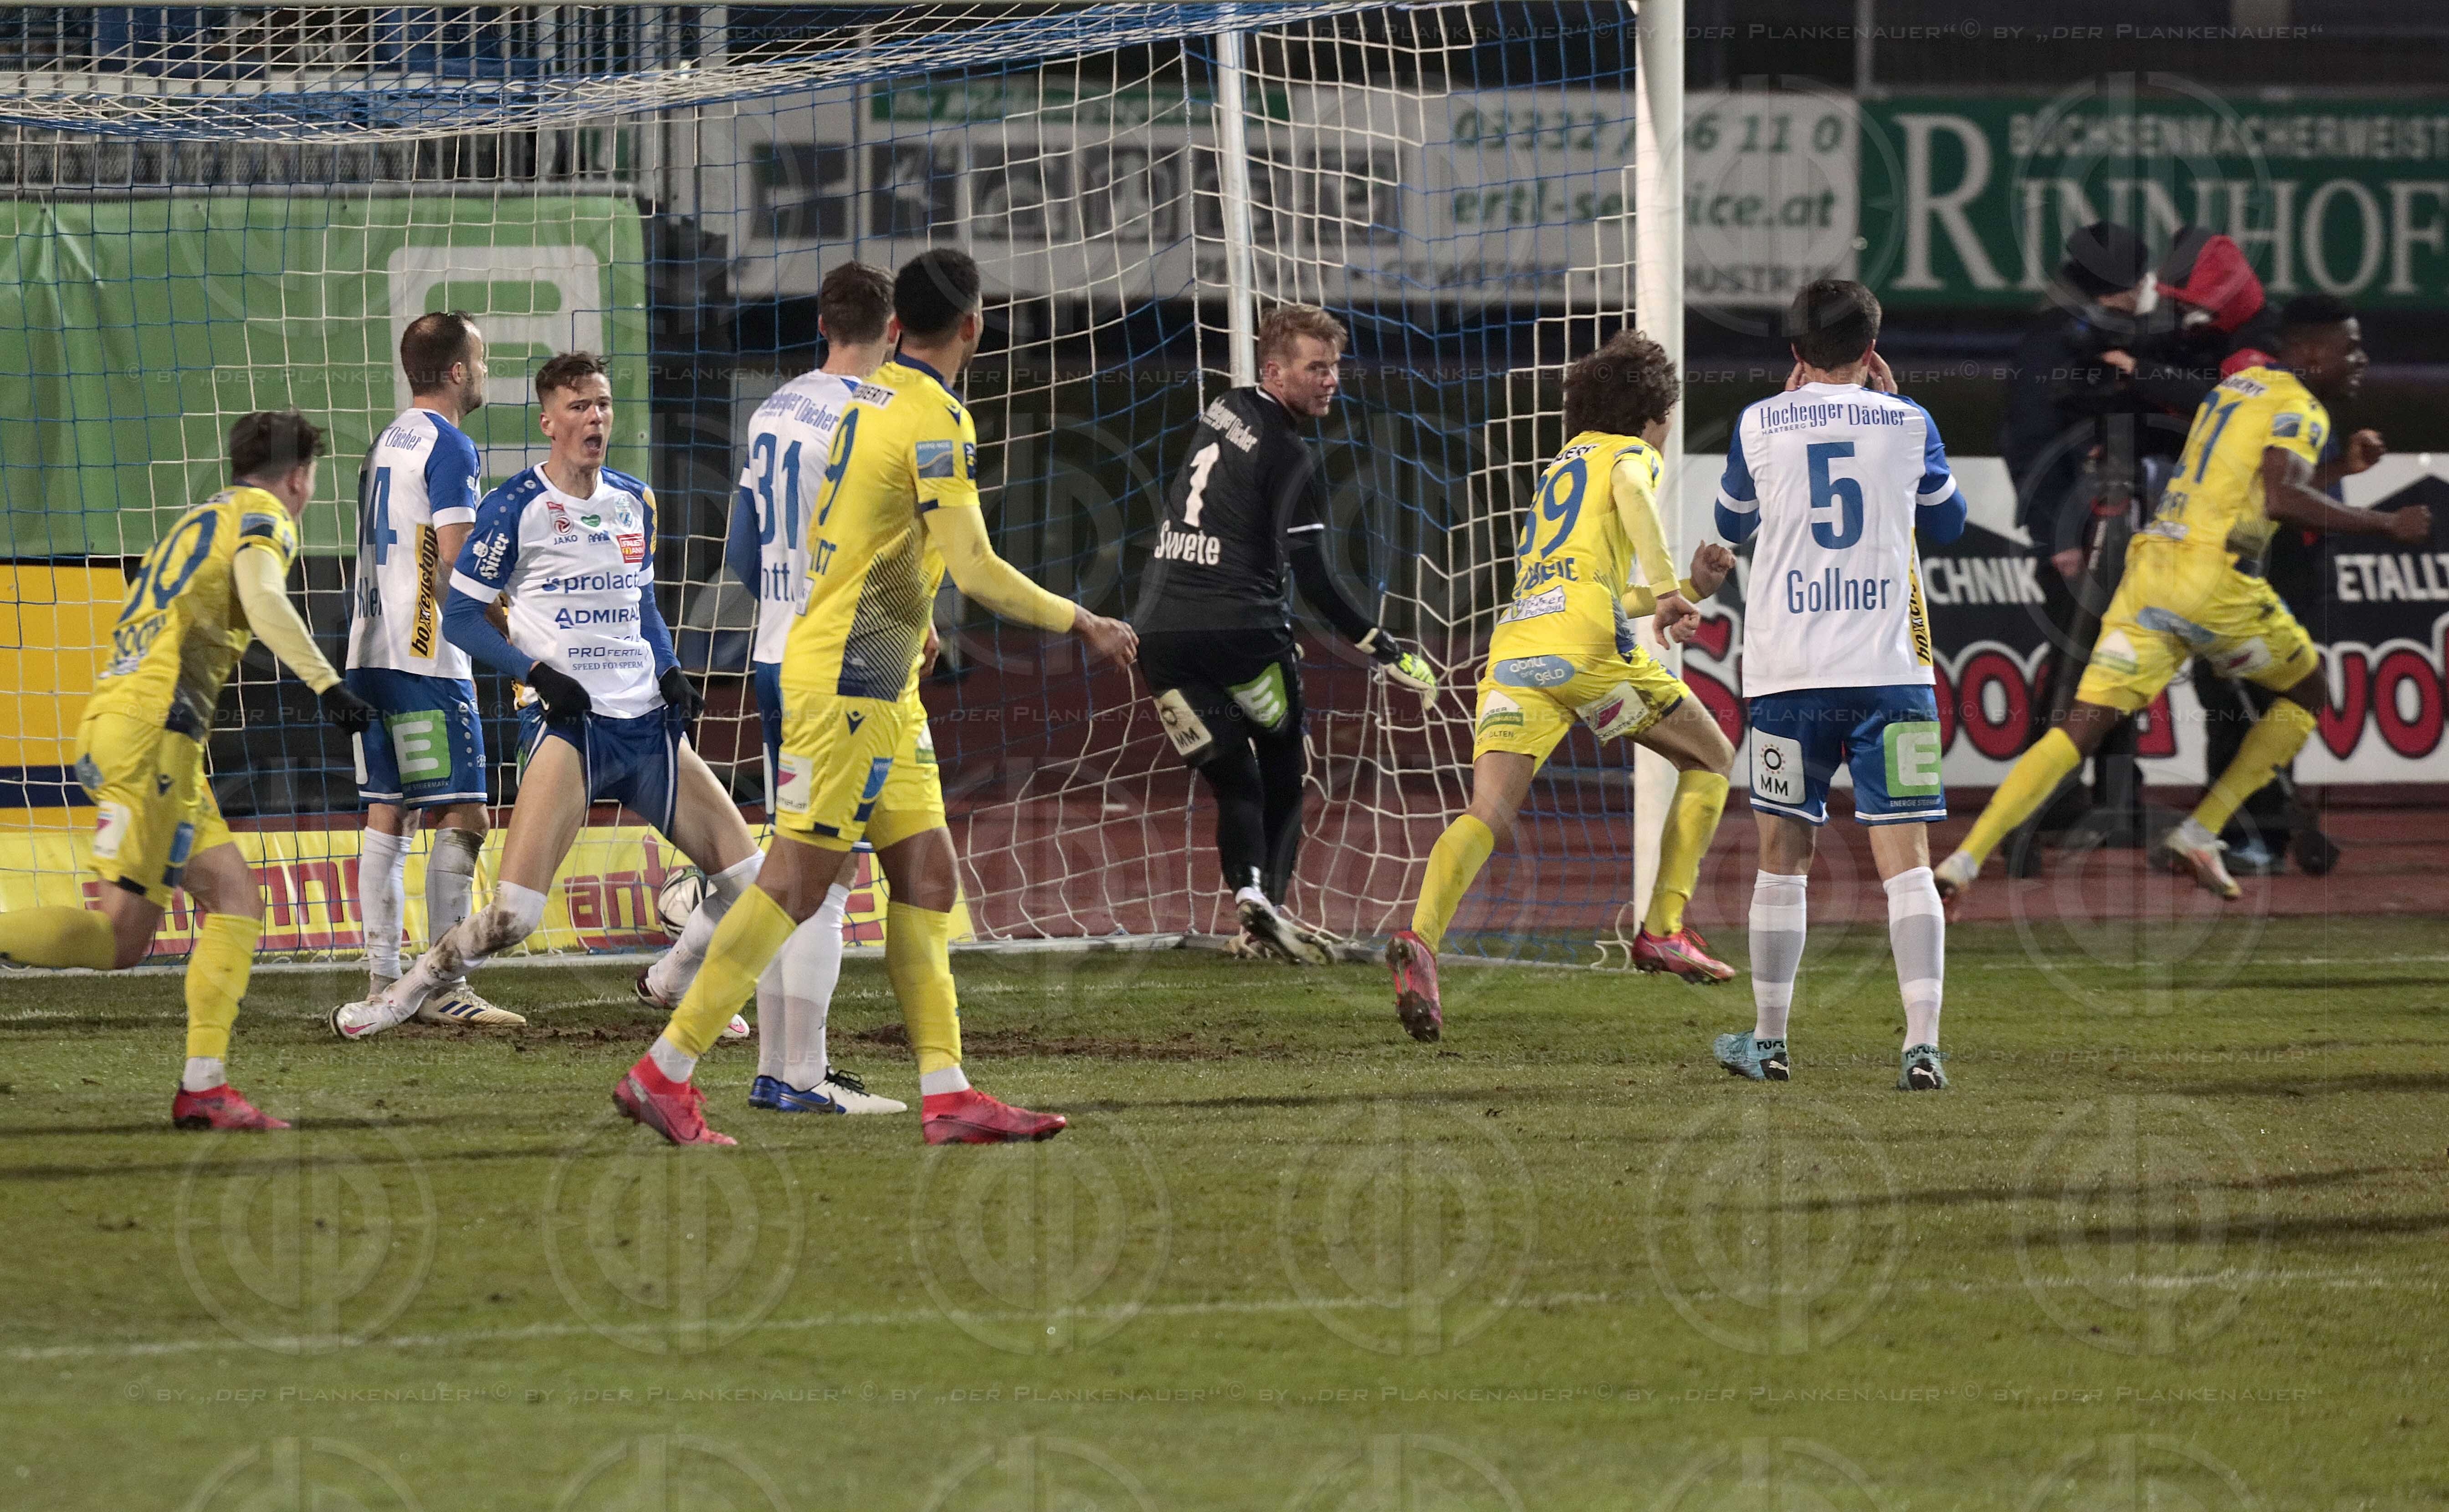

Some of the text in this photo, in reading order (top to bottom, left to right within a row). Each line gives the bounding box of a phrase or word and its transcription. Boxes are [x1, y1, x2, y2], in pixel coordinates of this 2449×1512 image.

[1739, 112, 1792, 154] 11
[1813, 113, 1842, 153] 0
[1454, 180, 1835, 228] ertl-seice.at
[1891, 114, 2449, 294] RINNHOF
[1760, 402, 1906, 428] Hochegger Dächer
[1761, 423, 1807, 436] HARTBERG
[753, 433, 802, 550] 31
[1184, 442, 1221, 527] 1
[1806, 441, 1864, 550] 5
[553, 534, 578, 545] JAKO
[1154, 519, 1221, 566] Swete
[564, 572, 639, 594] prolact
[1787, 567, 1891, 614] Gollner
[1760, 774, 1789, 796] MM
